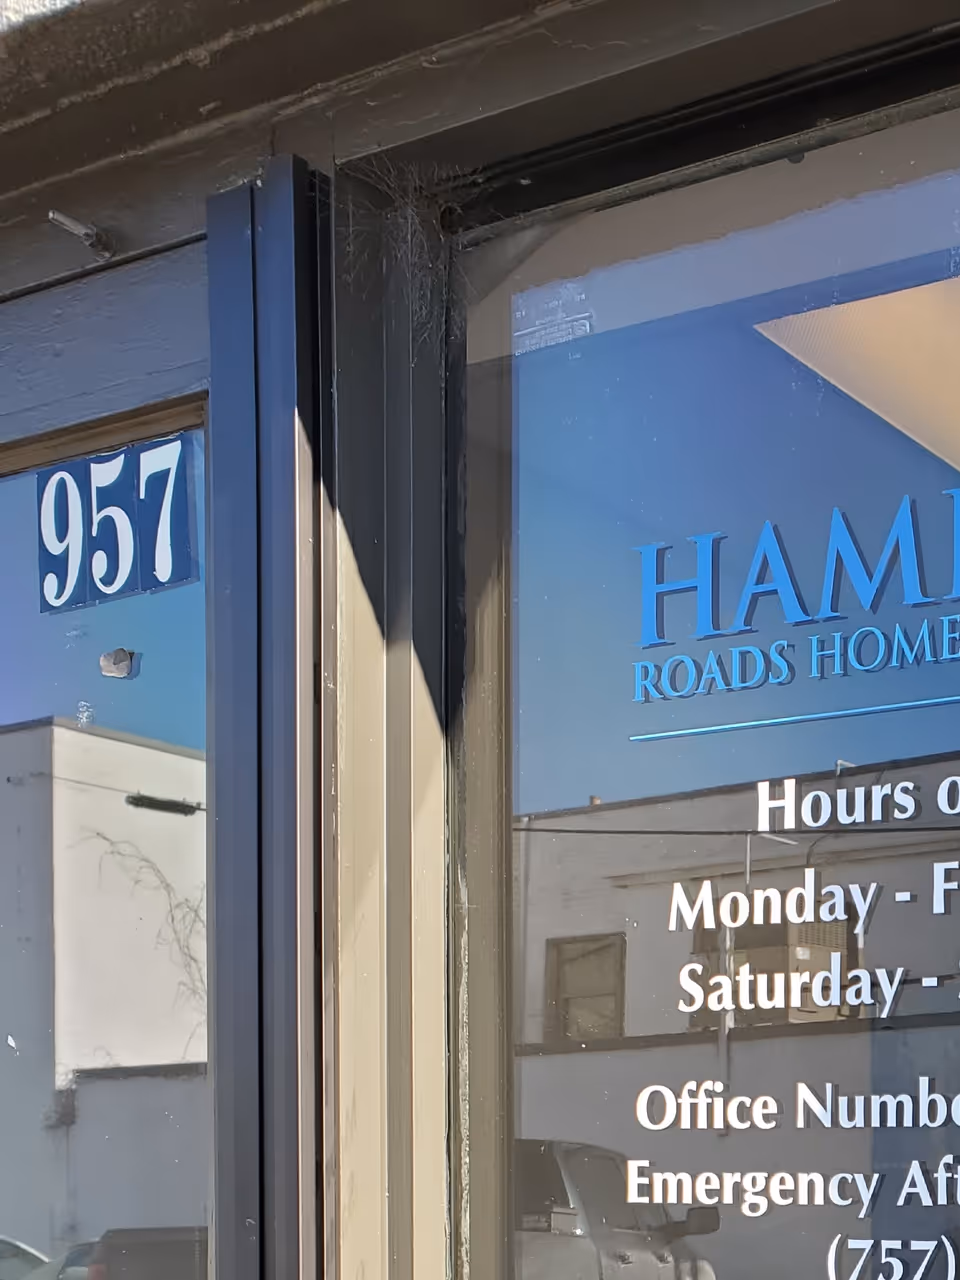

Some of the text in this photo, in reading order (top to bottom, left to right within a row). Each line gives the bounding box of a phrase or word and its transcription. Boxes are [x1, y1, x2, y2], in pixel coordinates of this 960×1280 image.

[40, 440, 182, 607] 957
[631, 640, 790, 703] ROADS
[756, 776, 915, 833] Hours
[668, 869, 878, 934] Monday
[677, 952, 905, 1017] Saturday
[635, 1080, 778, 1131] Office
[626, 1161, 880, 1219] Emergency
